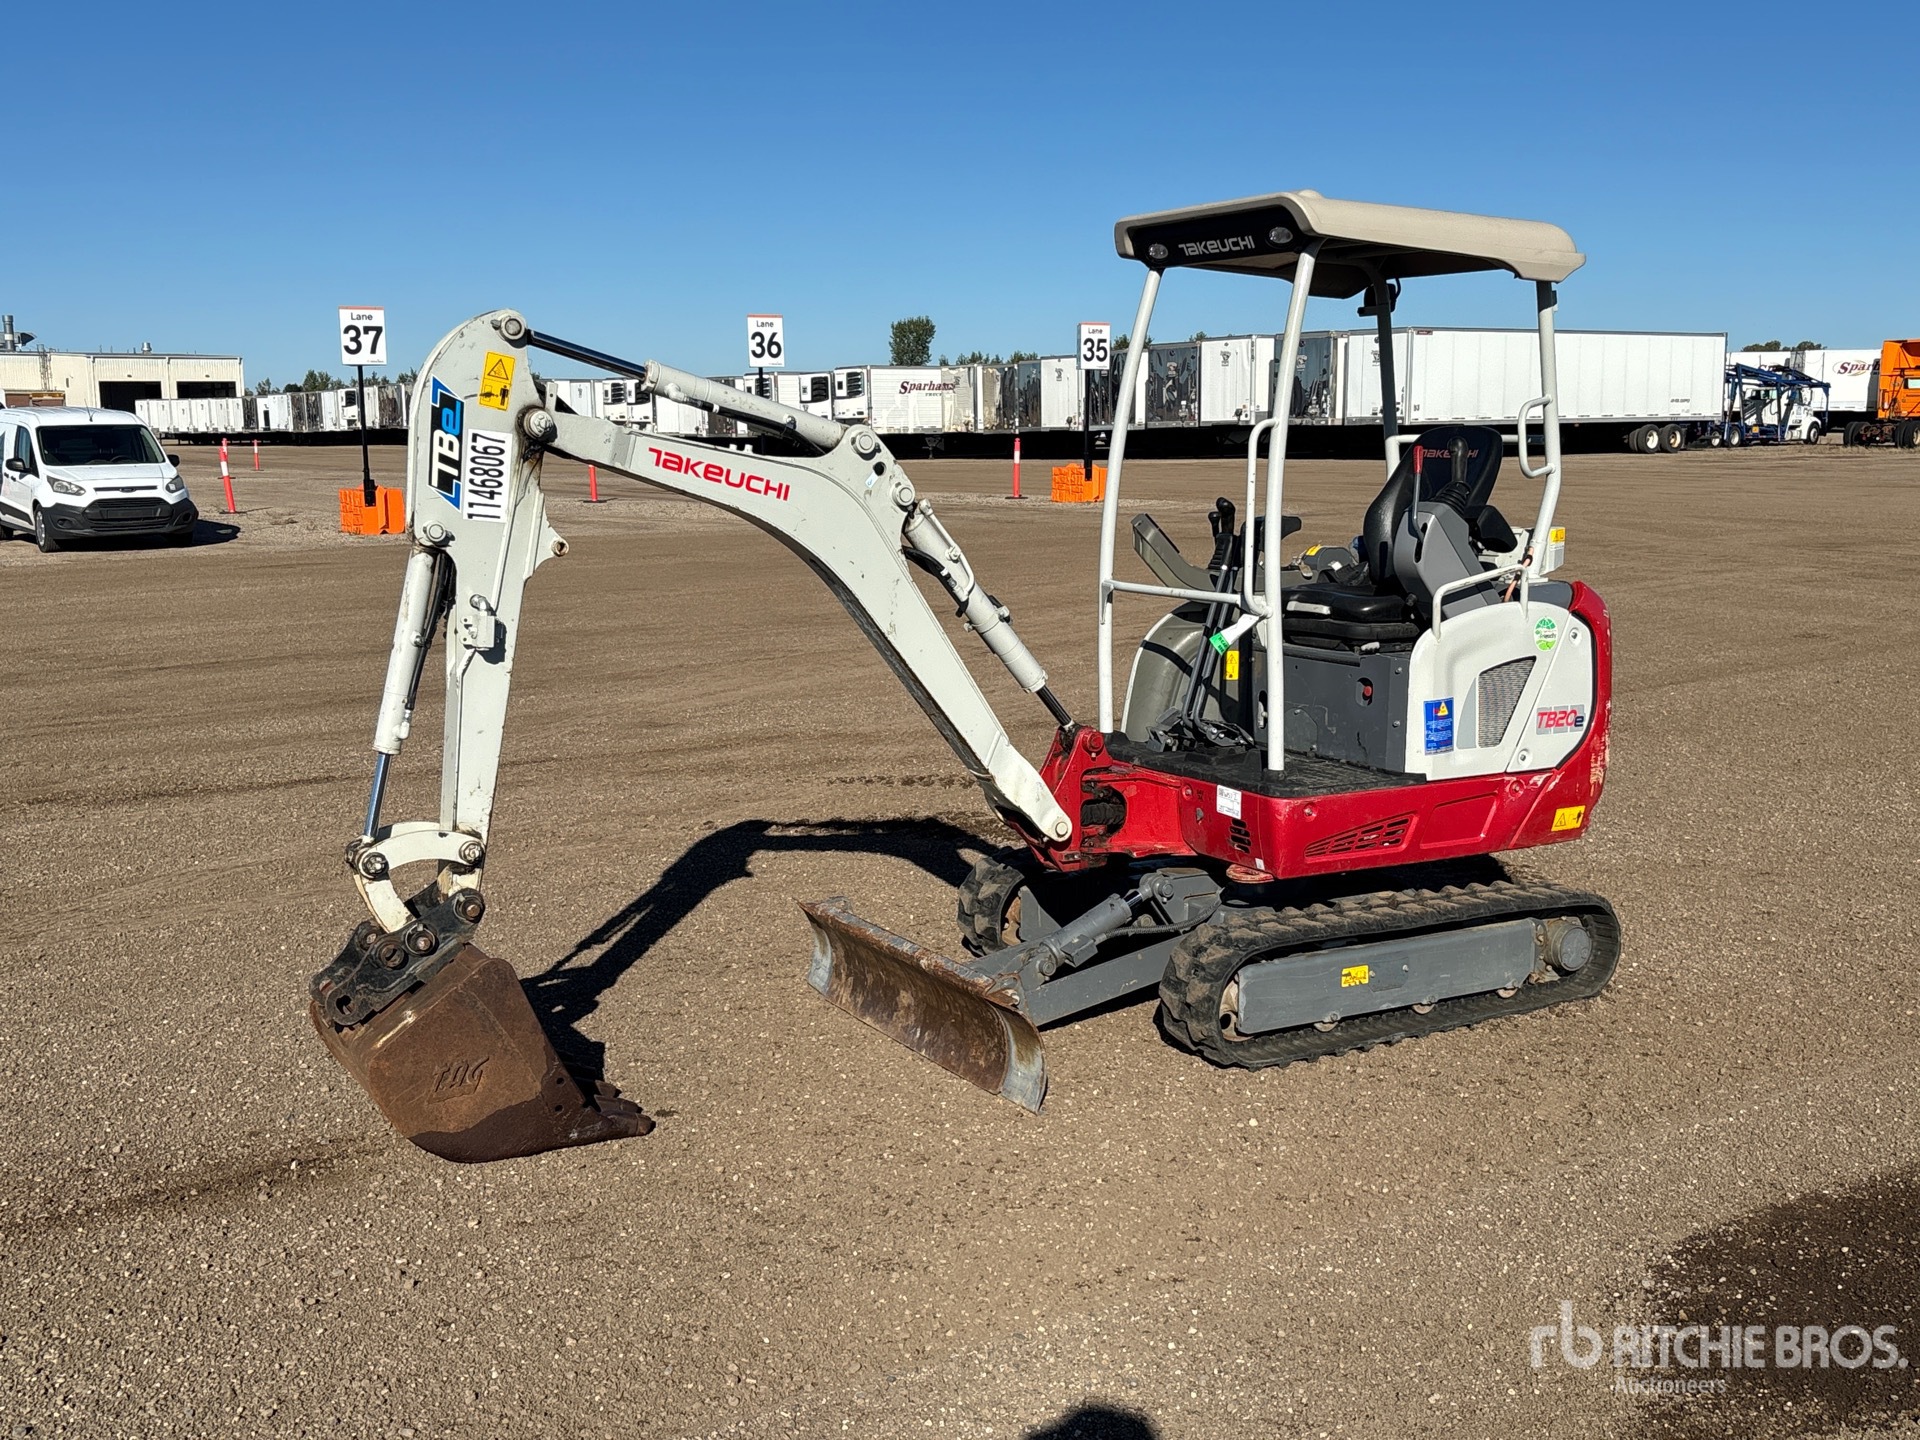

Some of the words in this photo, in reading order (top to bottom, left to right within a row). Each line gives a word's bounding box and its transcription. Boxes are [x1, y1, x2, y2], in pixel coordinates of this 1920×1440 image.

[350, 312, 373, 321] Lane
[756, 320, 774, 328] Lane
[343, 324, 383, 355] 37
[751, 331, 782, 359] 36
[1083, 337, 1108, 362] 35
[467, 432, 506, 520] 11468067
